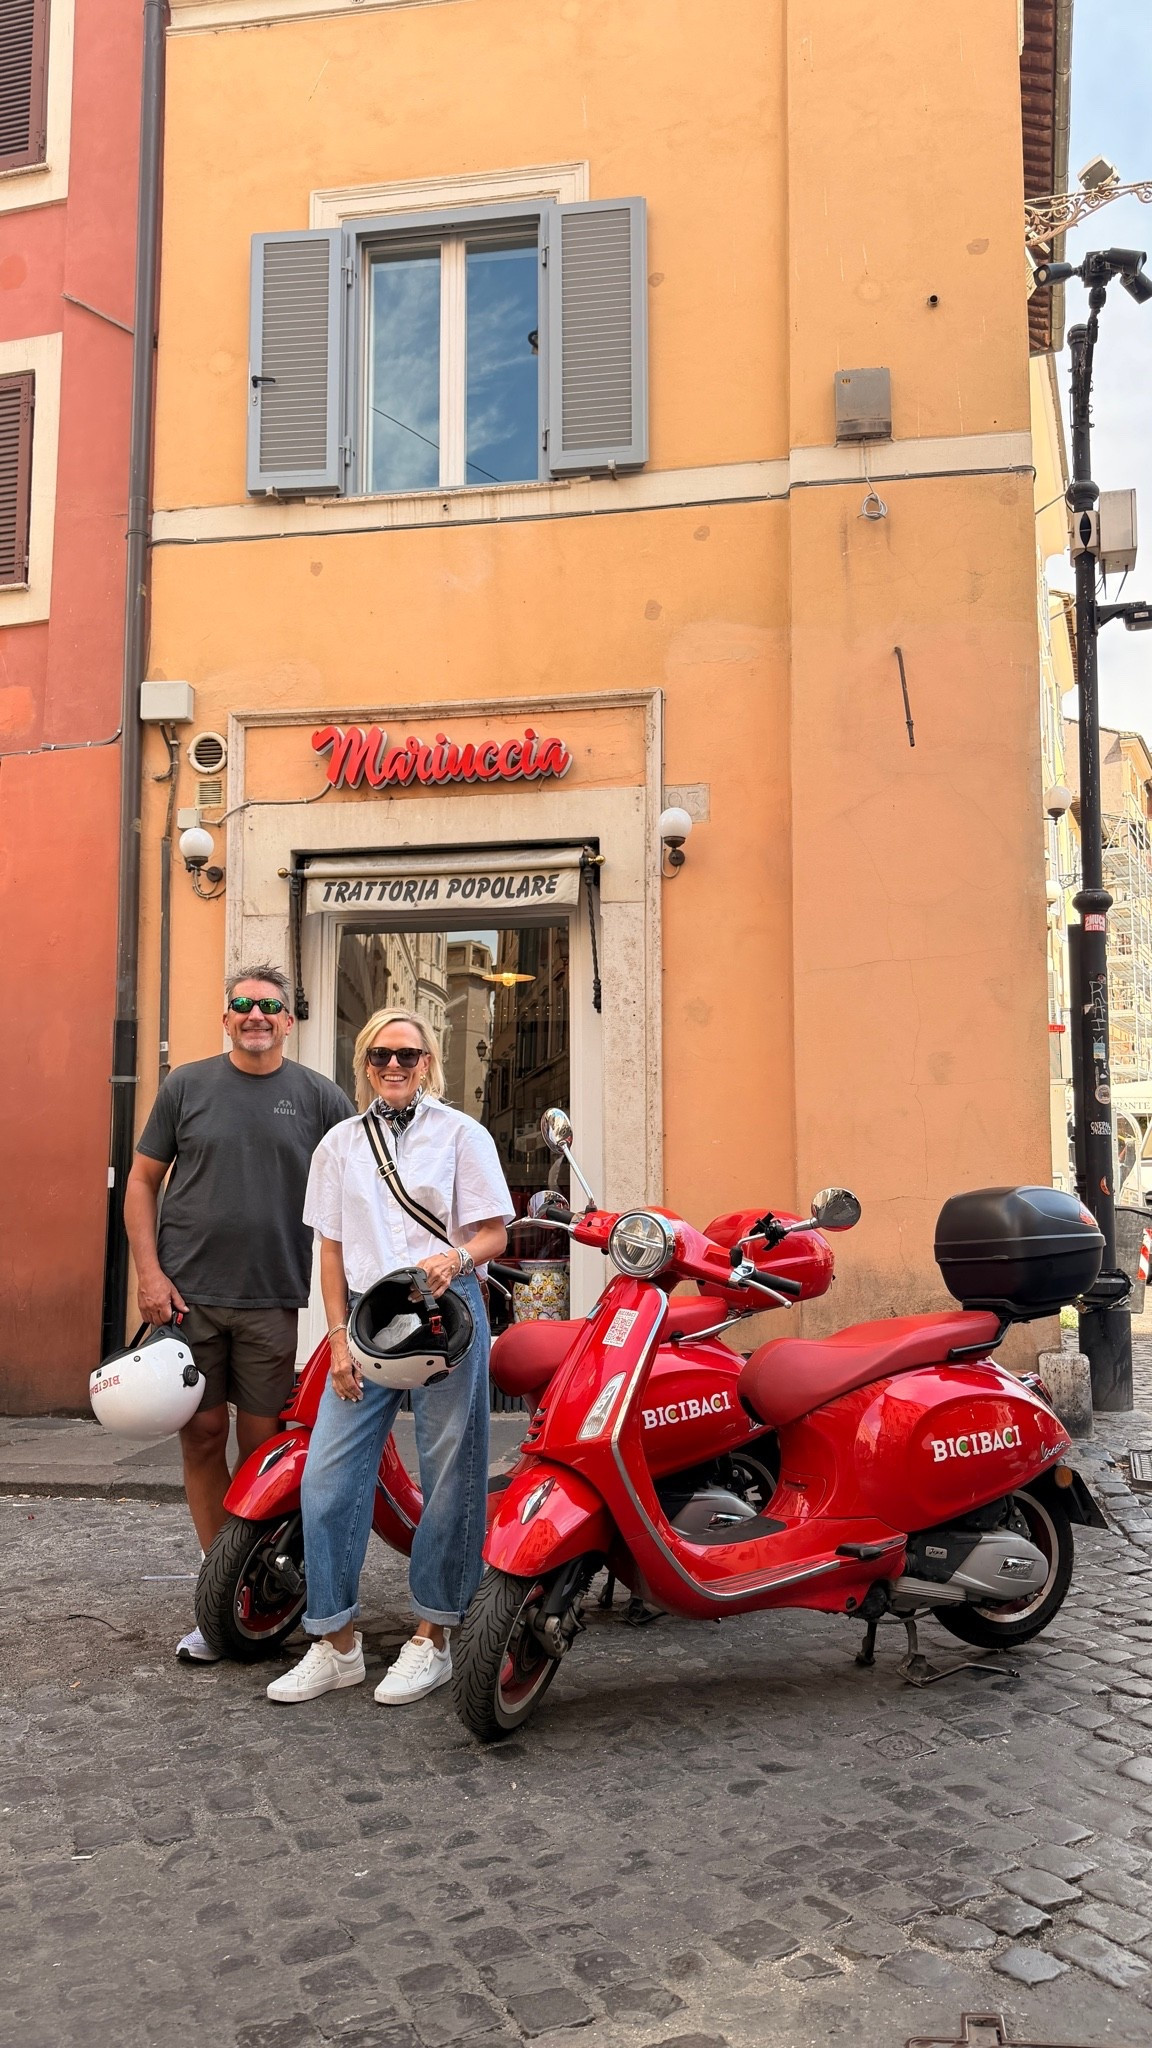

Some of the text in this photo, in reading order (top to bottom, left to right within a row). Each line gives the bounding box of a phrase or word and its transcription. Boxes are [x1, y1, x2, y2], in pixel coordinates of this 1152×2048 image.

[312, 726, 571, 789] Mariuccia
[322, 874, 560, 904] TRATTORIA POPOLARE
[273, 1107, 296, 1116] KUIU
[1112, 1101, 1151, 1110] RANTE
[642, 1391, 731, 1430] BICIBACI
[931, 1425, 1023, 1462] BICIBACI
